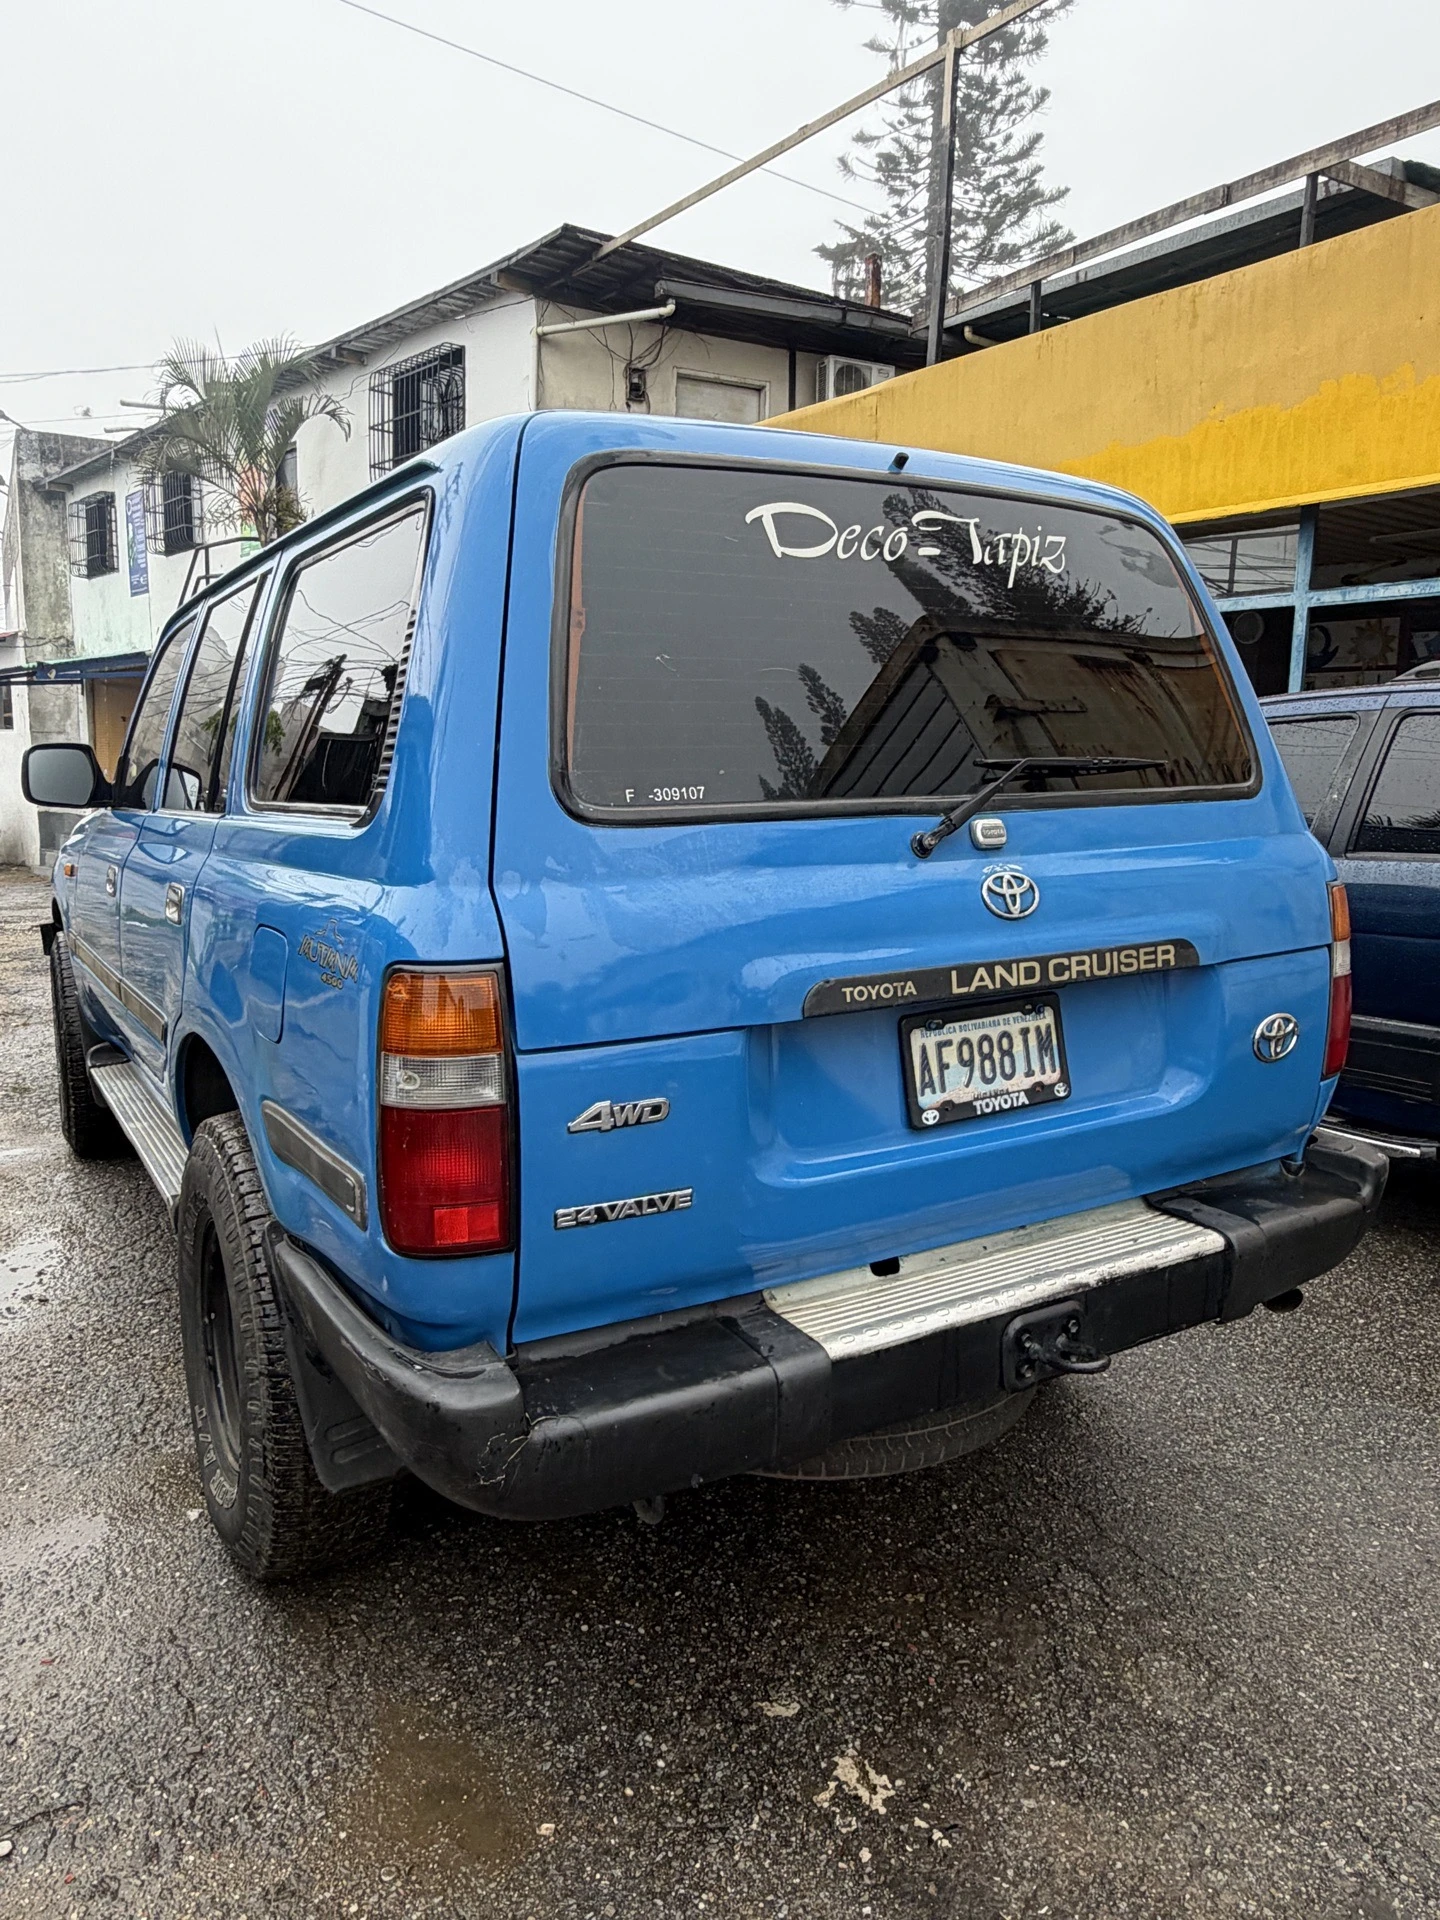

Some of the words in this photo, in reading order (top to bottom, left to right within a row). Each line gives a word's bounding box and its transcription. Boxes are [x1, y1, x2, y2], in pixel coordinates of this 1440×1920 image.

[841, 980, 918, 1003] TOYOTA
[950, 964, 1042, 995] LAND
[1048, 944, 1176, 983] CRUISER
[567, 1097, 670, 1133] 4WD
[972, 1091, 1029, 1115] TOYOTA
[554, 1207, 598, 1231] 24
[602, 1187, 693, 1221] VALVE
